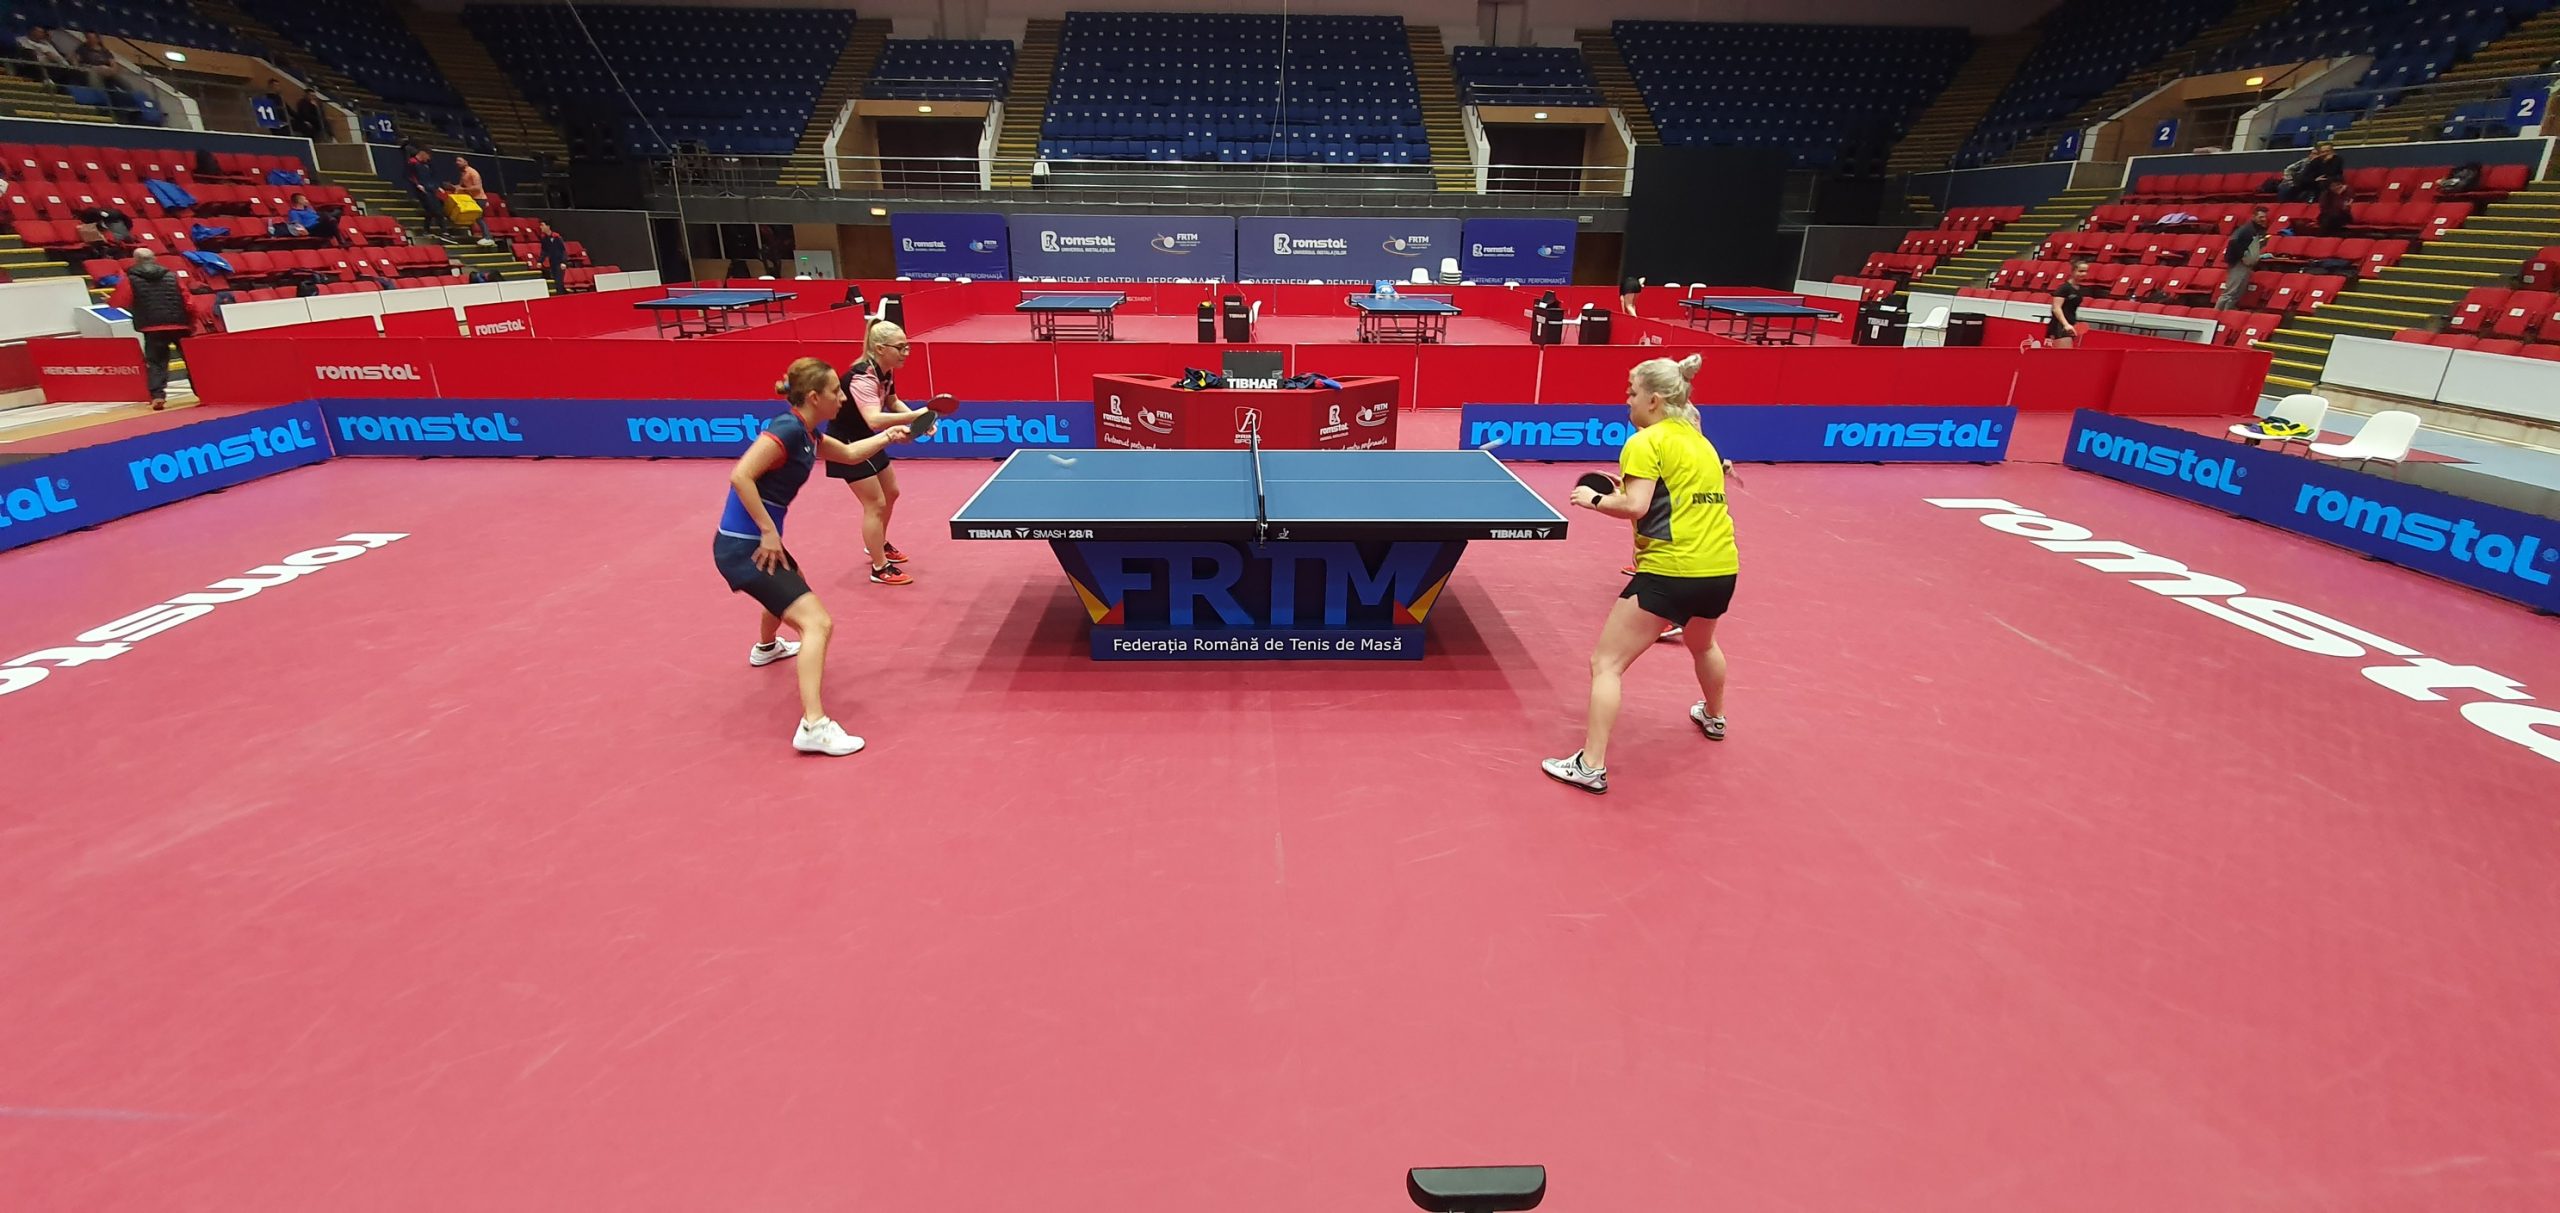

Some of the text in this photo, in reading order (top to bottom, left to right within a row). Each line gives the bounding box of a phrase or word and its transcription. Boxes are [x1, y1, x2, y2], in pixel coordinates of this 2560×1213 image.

[257, 105, 276, 121] 11
[2517, 98, 2536, 117] 2
[378, 119, 395, 133] 12
[2159, 127, 2171, 141] 2
[2065, 136, 2073, 149] 1
[1176, 233, 1198, 241] FRTM
[1408, 235, 1430, 243] FRTM
[474, 318, 526, 336] romstal
[315, 363, 421, 380] romstal
[1226, 378, 1278, 389] TIBHAR
[338, 412, 1069, 442] romstal romst mstal
[1823, 418, 2000, 448] romstal
[129, 418, 316, 491] romstal
[2077, 428, 2551, 585] romstal romstal
[968, 529, 1094, 539] TIBHAR SMASH 28/R
[1490, 529, 1533, 539] TIBHAR
[1076, 541, 1445, 625] FRTM
[1113, 637, 1402, 655] Federația Română de Tenis de Masă
